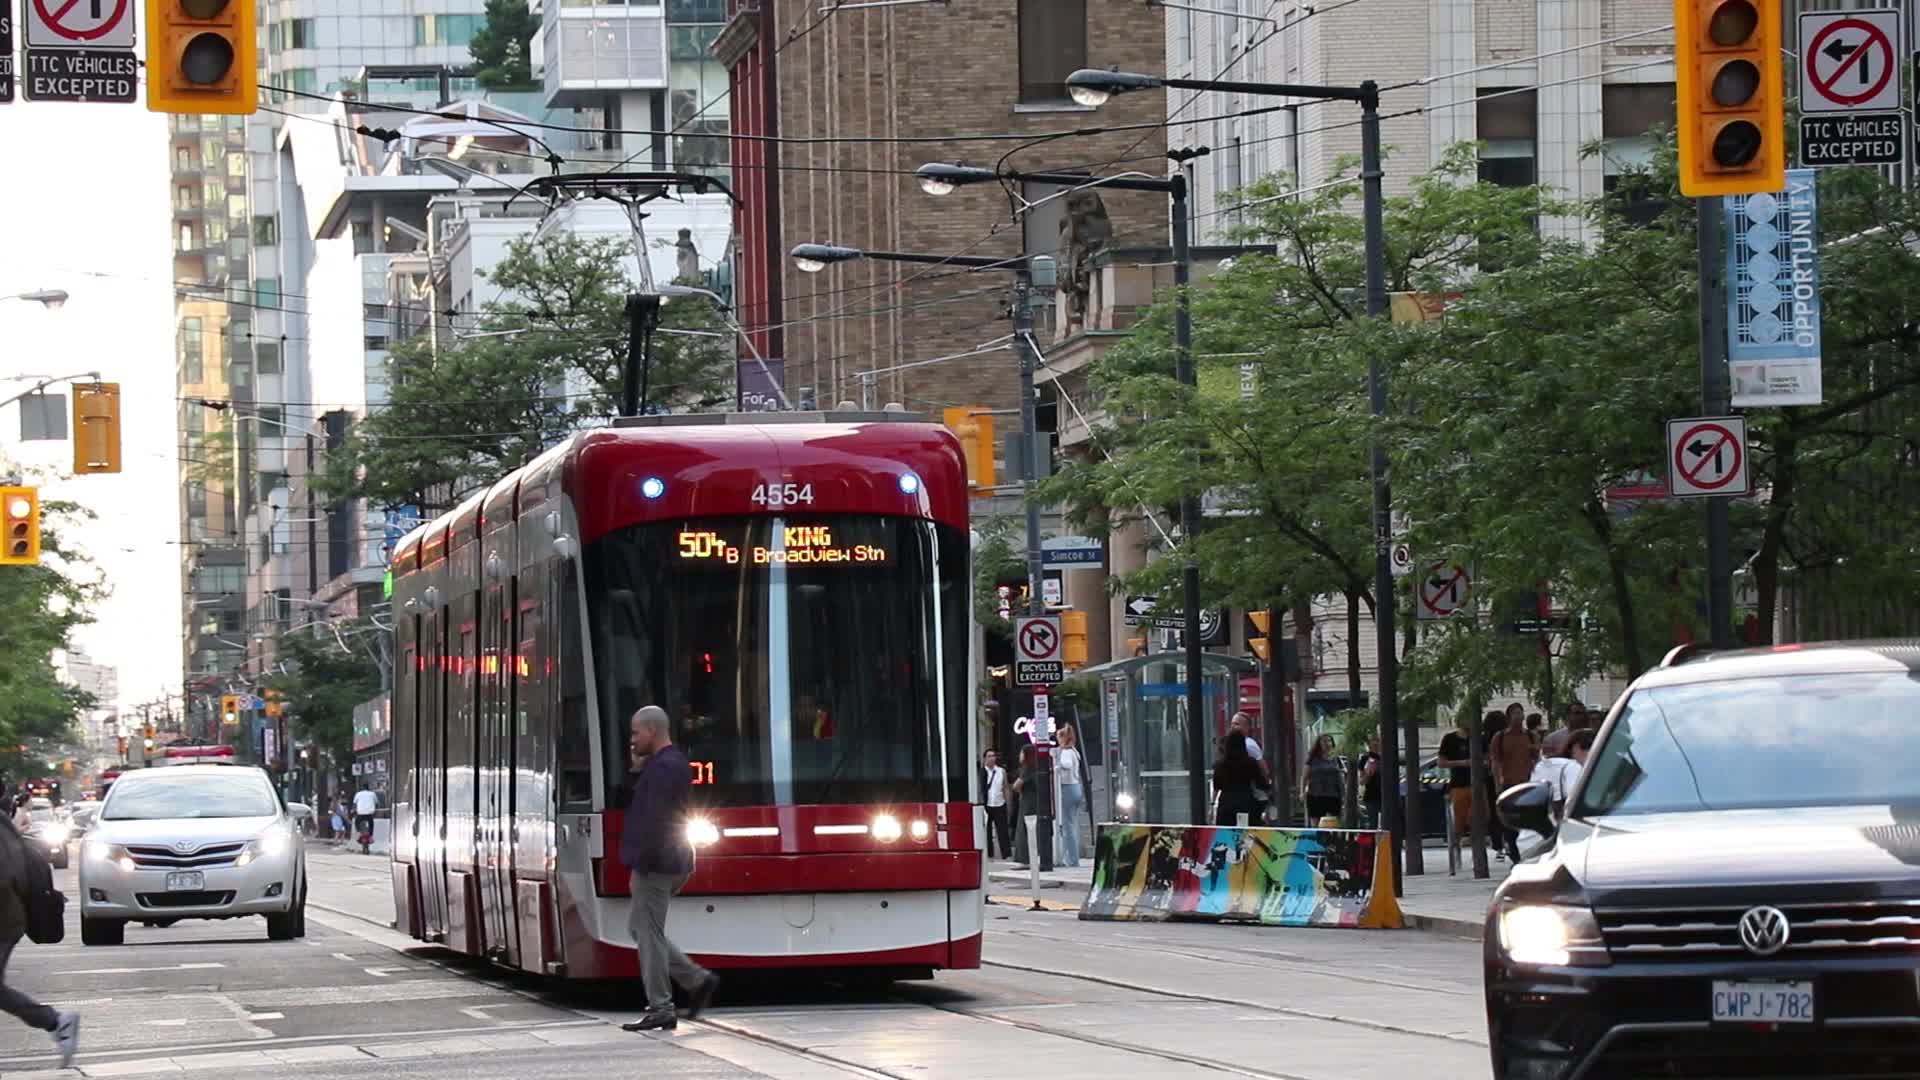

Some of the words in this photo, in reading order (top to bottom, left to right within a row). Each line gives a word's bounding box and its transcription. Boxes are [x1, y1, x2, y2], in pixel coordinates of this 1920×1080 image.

[29, 55, 59, 73] TTC
[65, 57, 135, 75] VEHICLES
[34, 77, 130, 96] EXCEPTED
[1803, 122, 1831, 139] TTC
[1836, 120, 1900, 138] VEHICLES
[1807, 140, 1896, 159] EXCEPTED
[1791, 180, 1815, 348] OPPORTUNITY
[751, 483, 814, 505] 4554
[784, 526, 832, 547] KING
[753, 547, 851, 564] Broadview
[854, 545, 885, 562] Stn
[1050, 551, 1084, 561] Simcoe
[1019, 672, 1061, 682] EXCEPTED
[1021, 663, 1058, 672] BICYCLES
